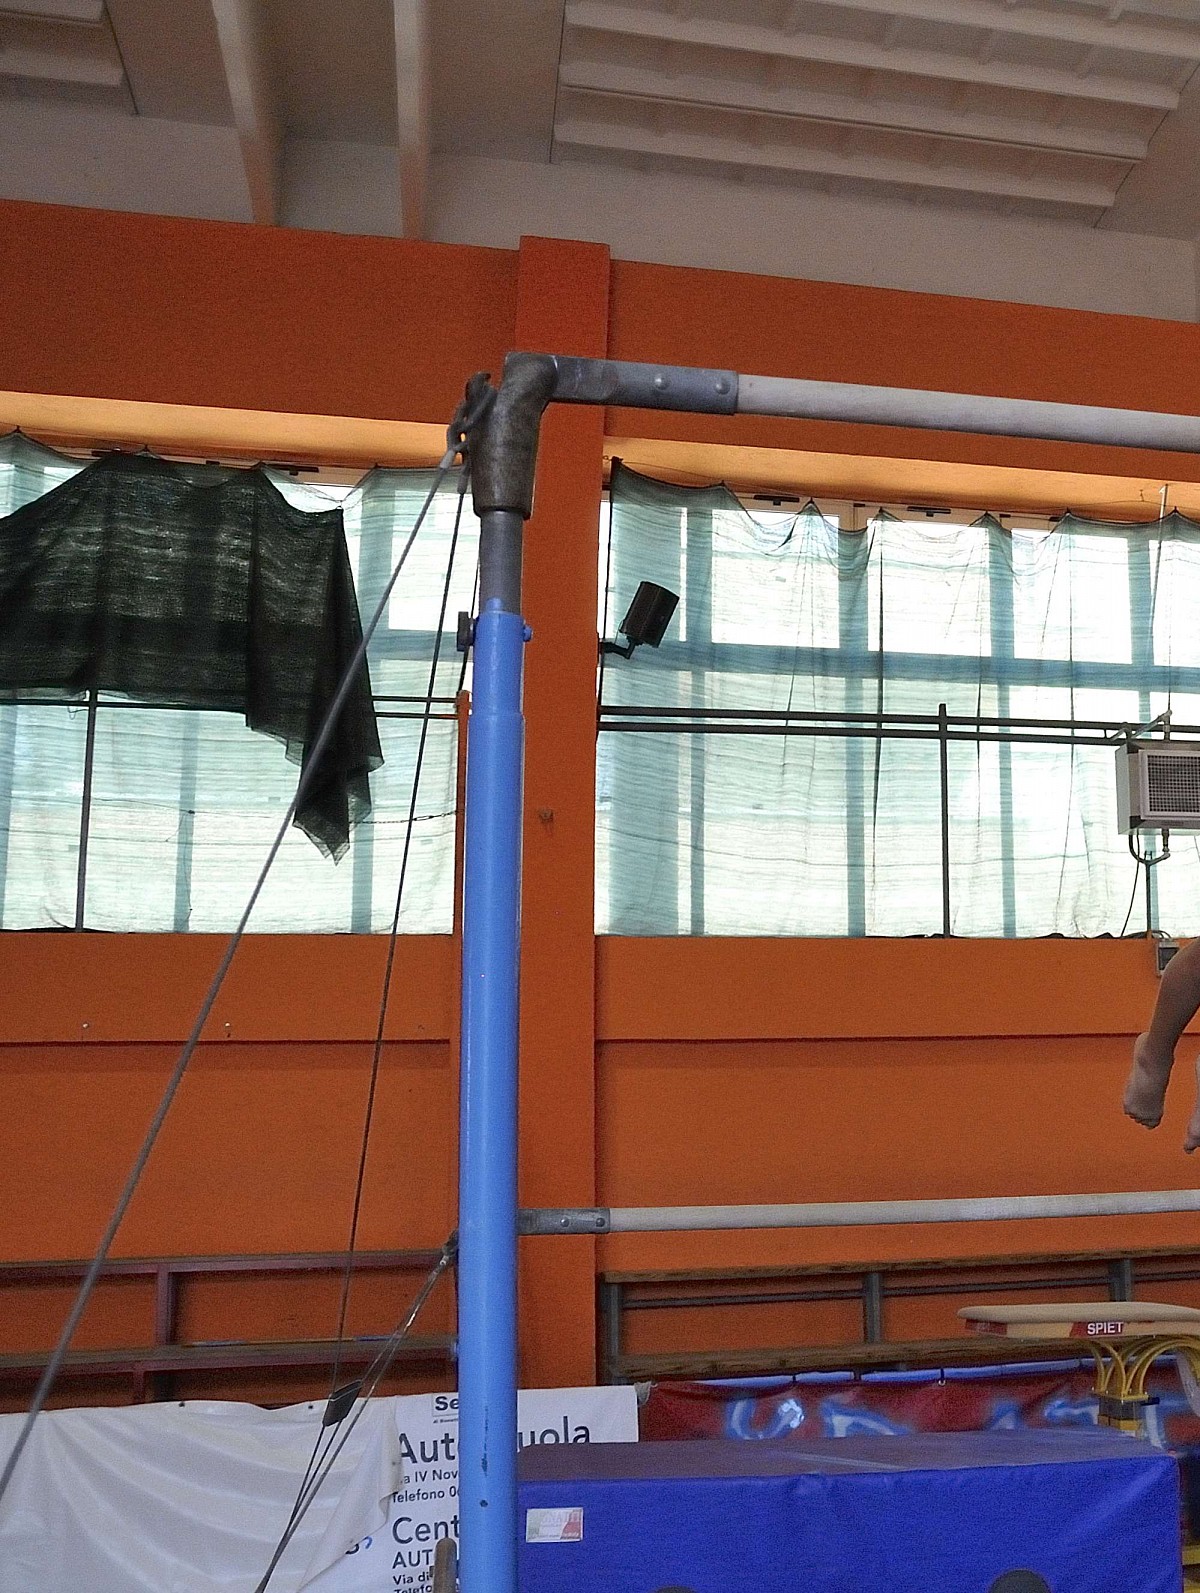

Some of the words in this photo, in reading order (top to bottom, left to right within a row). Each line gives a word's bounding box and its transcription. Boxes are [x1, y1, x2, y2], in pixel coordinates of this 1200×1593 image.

[1087, 1321, 1124, 1335] SPIET
[415, 1470, 428, 1482] IV
[392, 1488, 445, 1503] Telefono
[392, 1574, 414, 1585] Via
